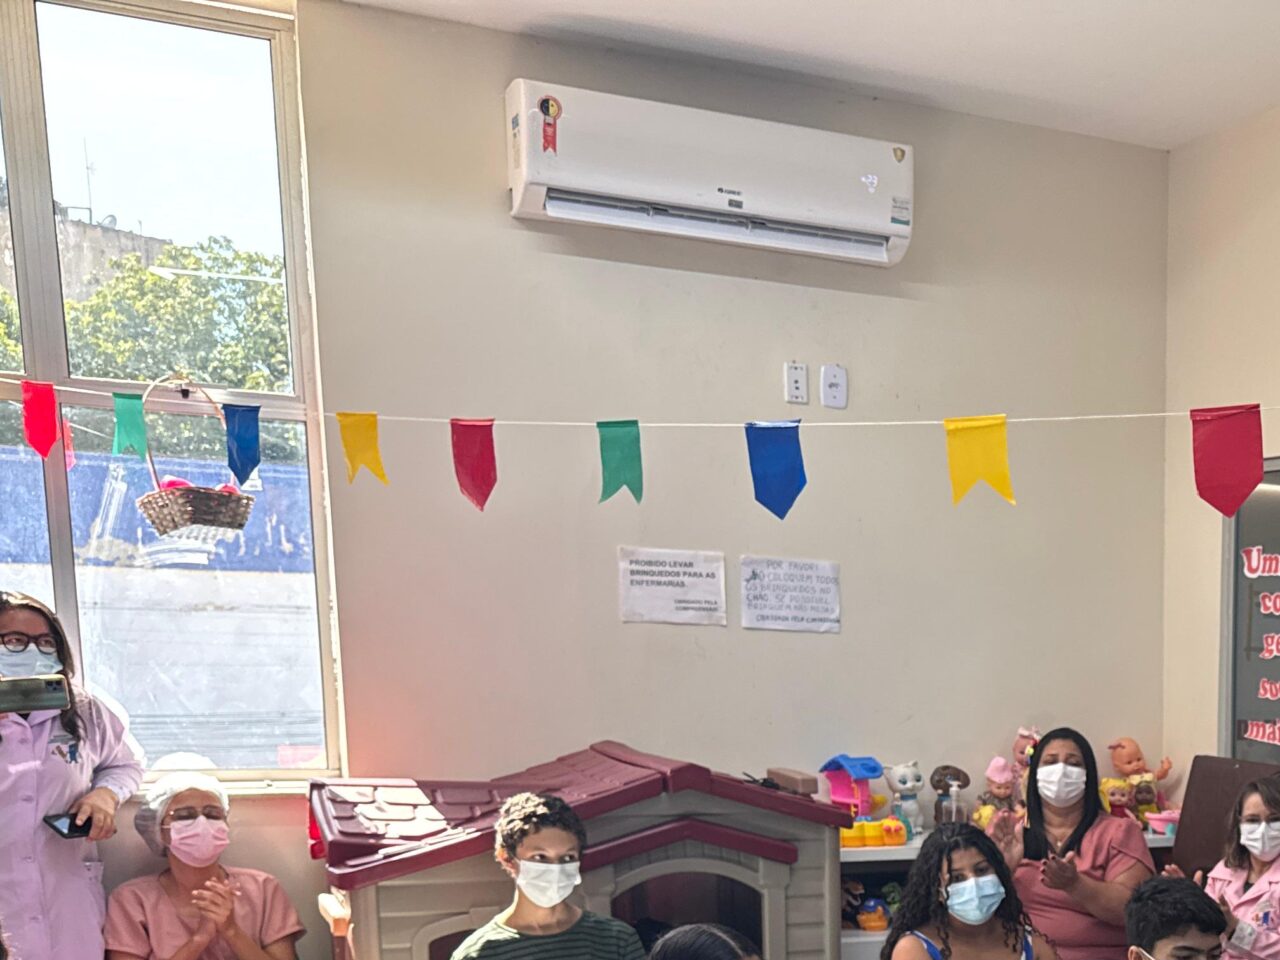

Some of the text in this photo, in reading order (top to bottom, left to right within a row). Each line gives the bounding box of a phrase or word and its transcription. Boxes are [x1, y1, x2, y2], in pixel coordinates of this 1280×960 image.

[629, 559, 694, 569] PROIBIDO LEVAR
[629, 569, 716, 580] BRINQUEDOS PARA AS
